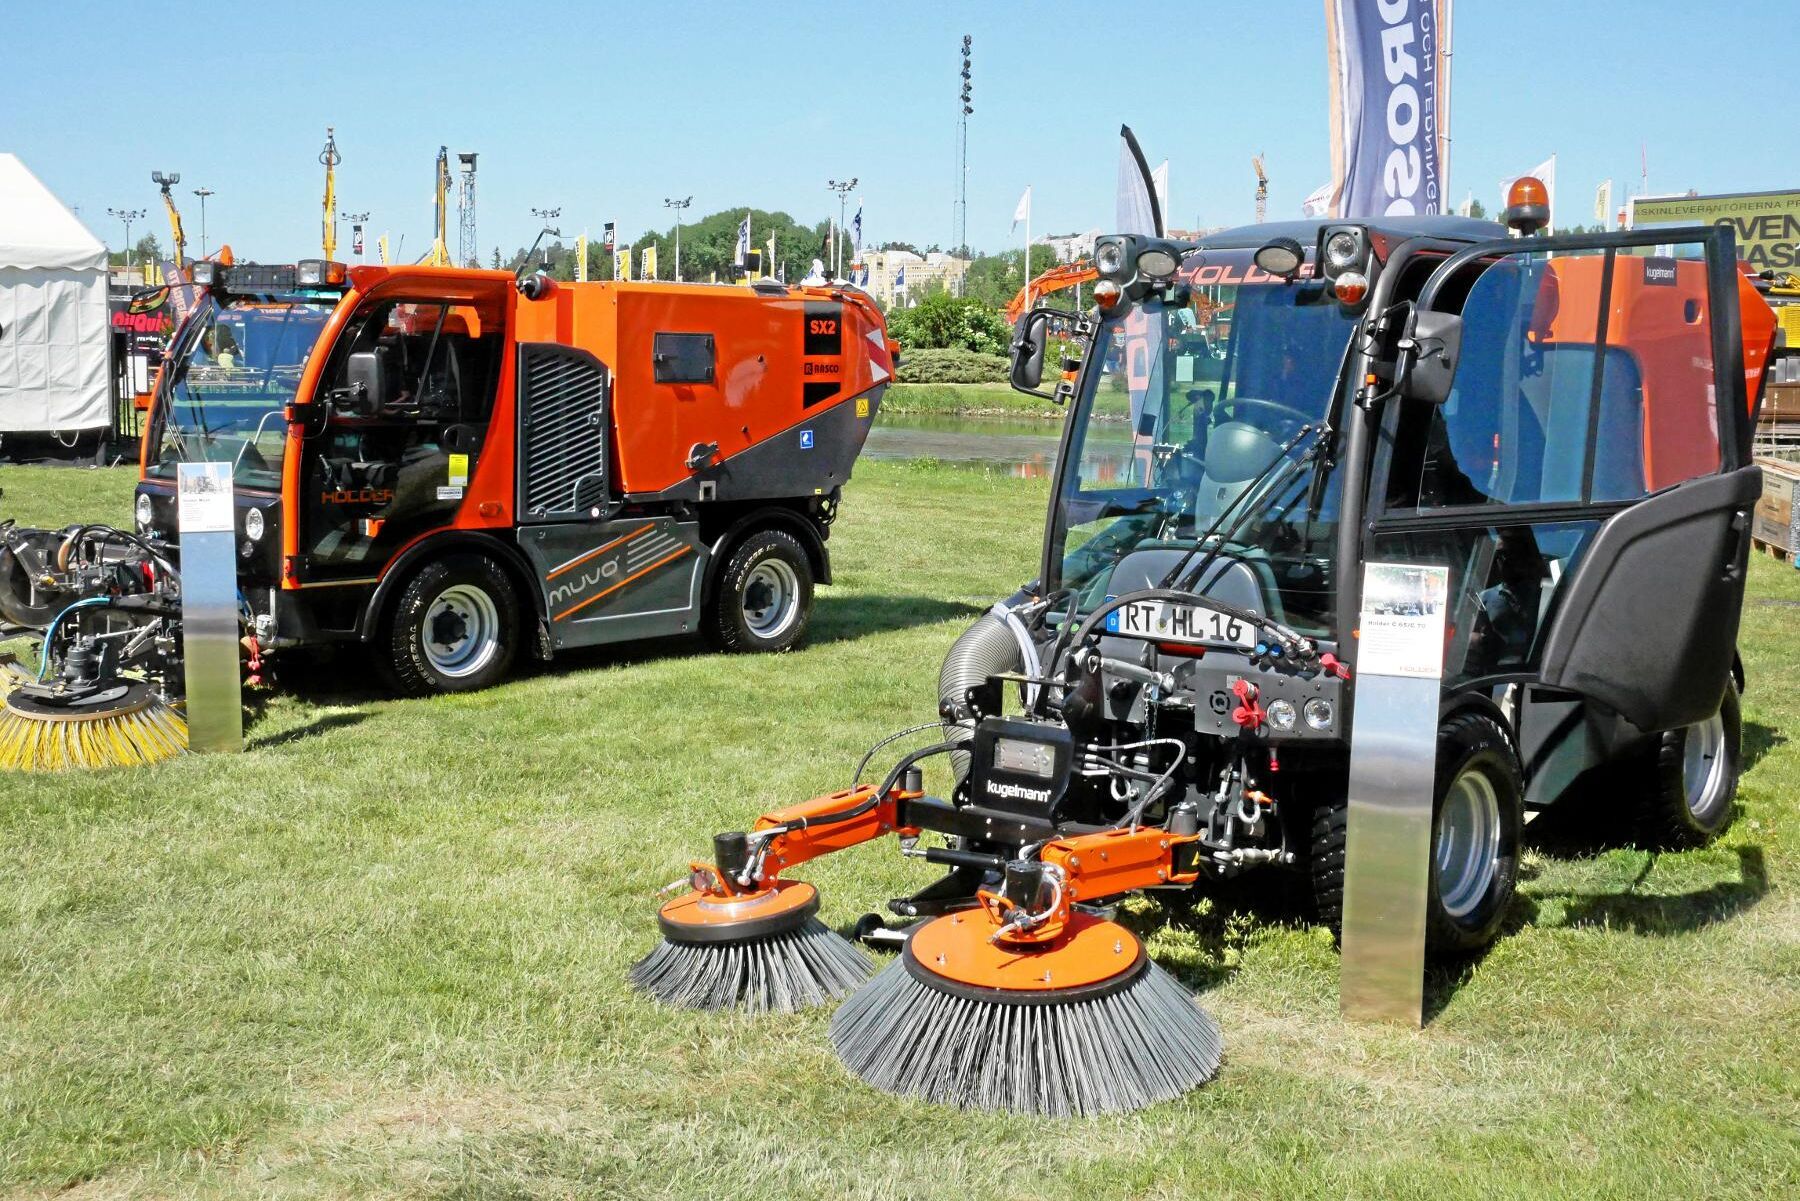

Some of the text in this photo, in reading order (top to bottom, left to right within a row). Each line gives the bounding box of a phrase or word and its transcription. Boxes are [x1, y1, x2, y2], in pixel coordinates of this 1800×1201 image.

[1178, 263, 1314, 284] HOLDR
[810, 320, 836, 334] SX2
[1126, 603, 1155, 632] RT
[1172, 608, 1204, 638] HL
[1210, 613, 1242, 642] 16
